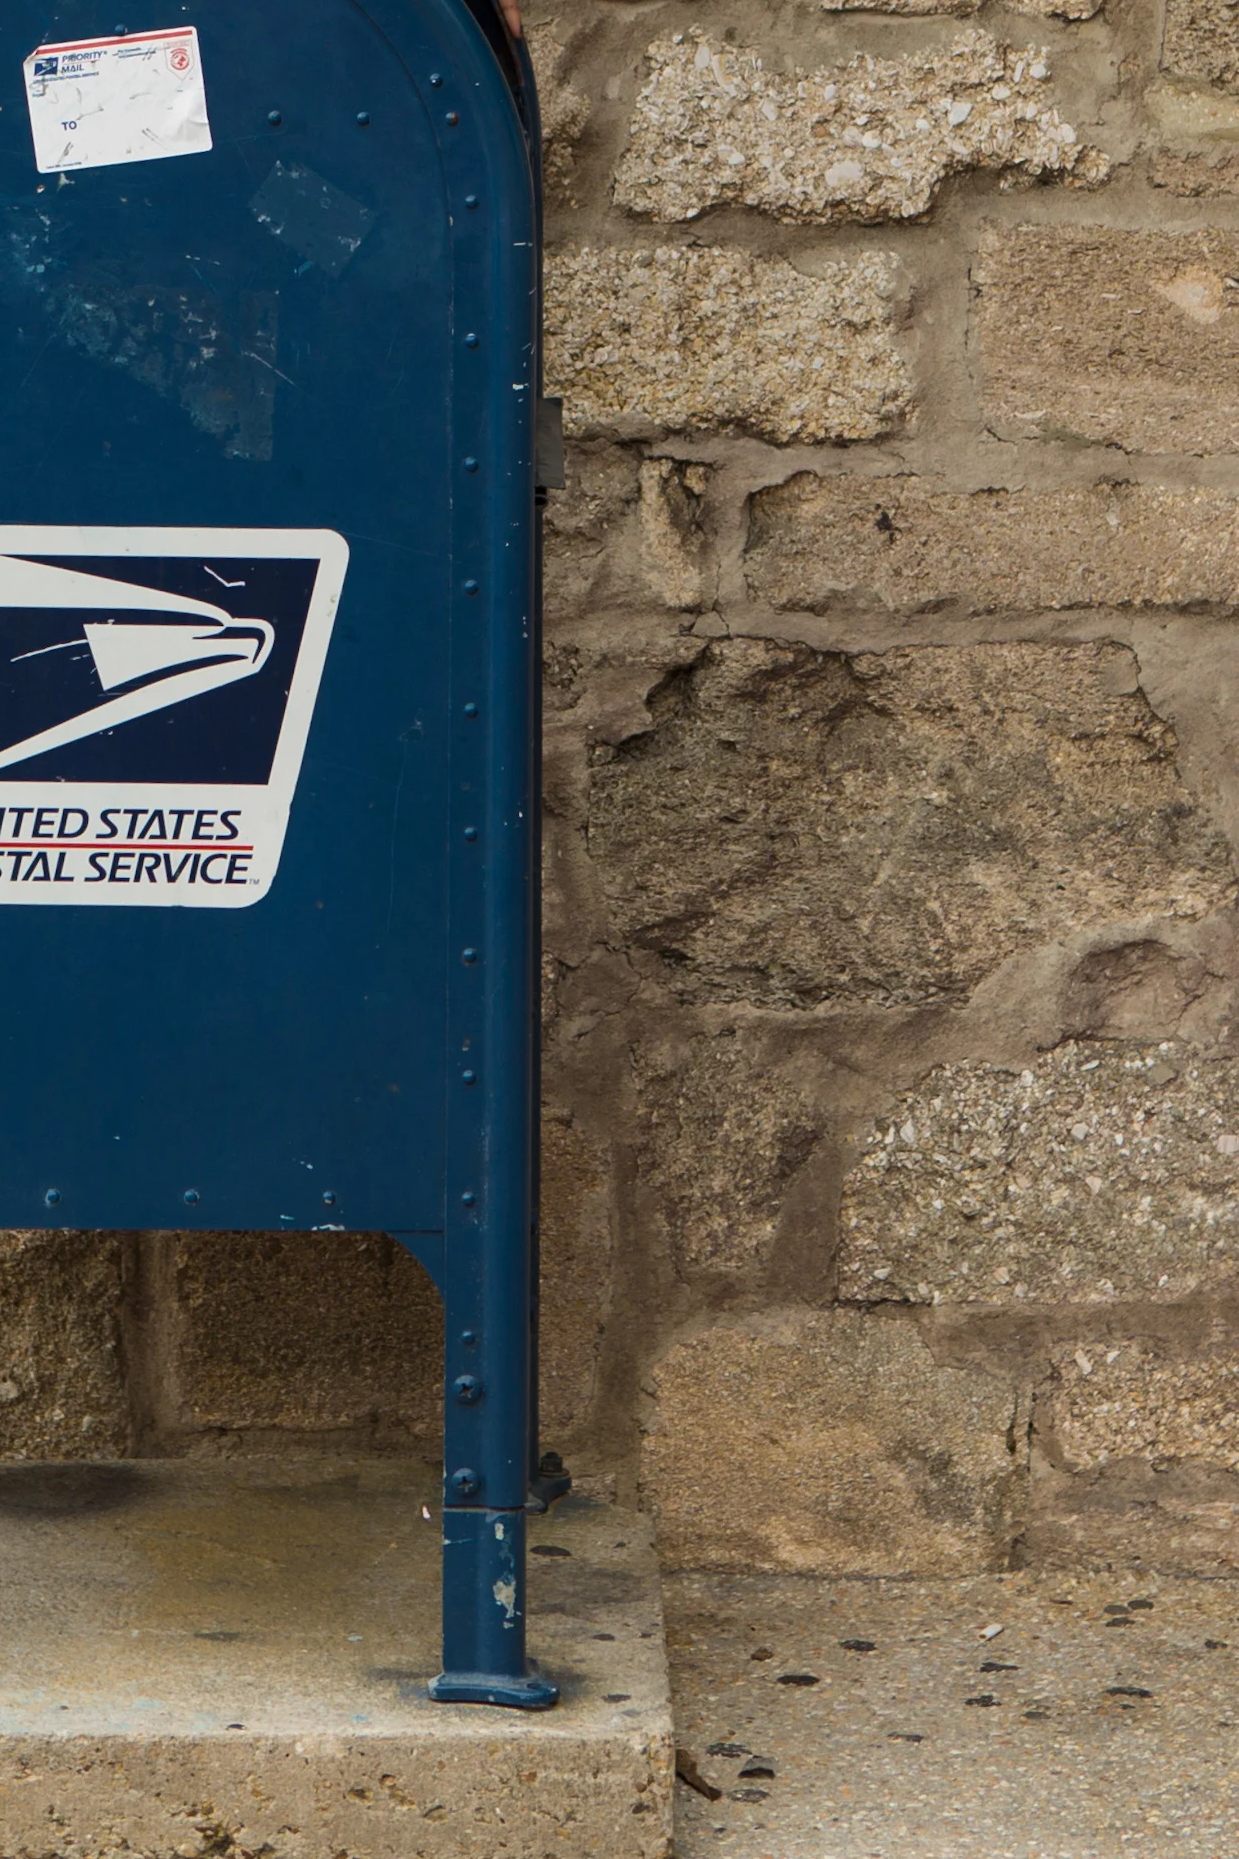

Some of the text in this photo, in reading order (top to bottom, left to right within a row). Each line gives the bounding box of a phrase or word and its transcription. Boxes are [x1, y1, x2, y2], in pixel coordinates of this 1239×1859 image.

[61, 63, 84, 73] MAIL
[61, 120, 78, 132] TO
[96, 808, 241, 841] STATES
[84, 852, 254, 886] SERVICE
